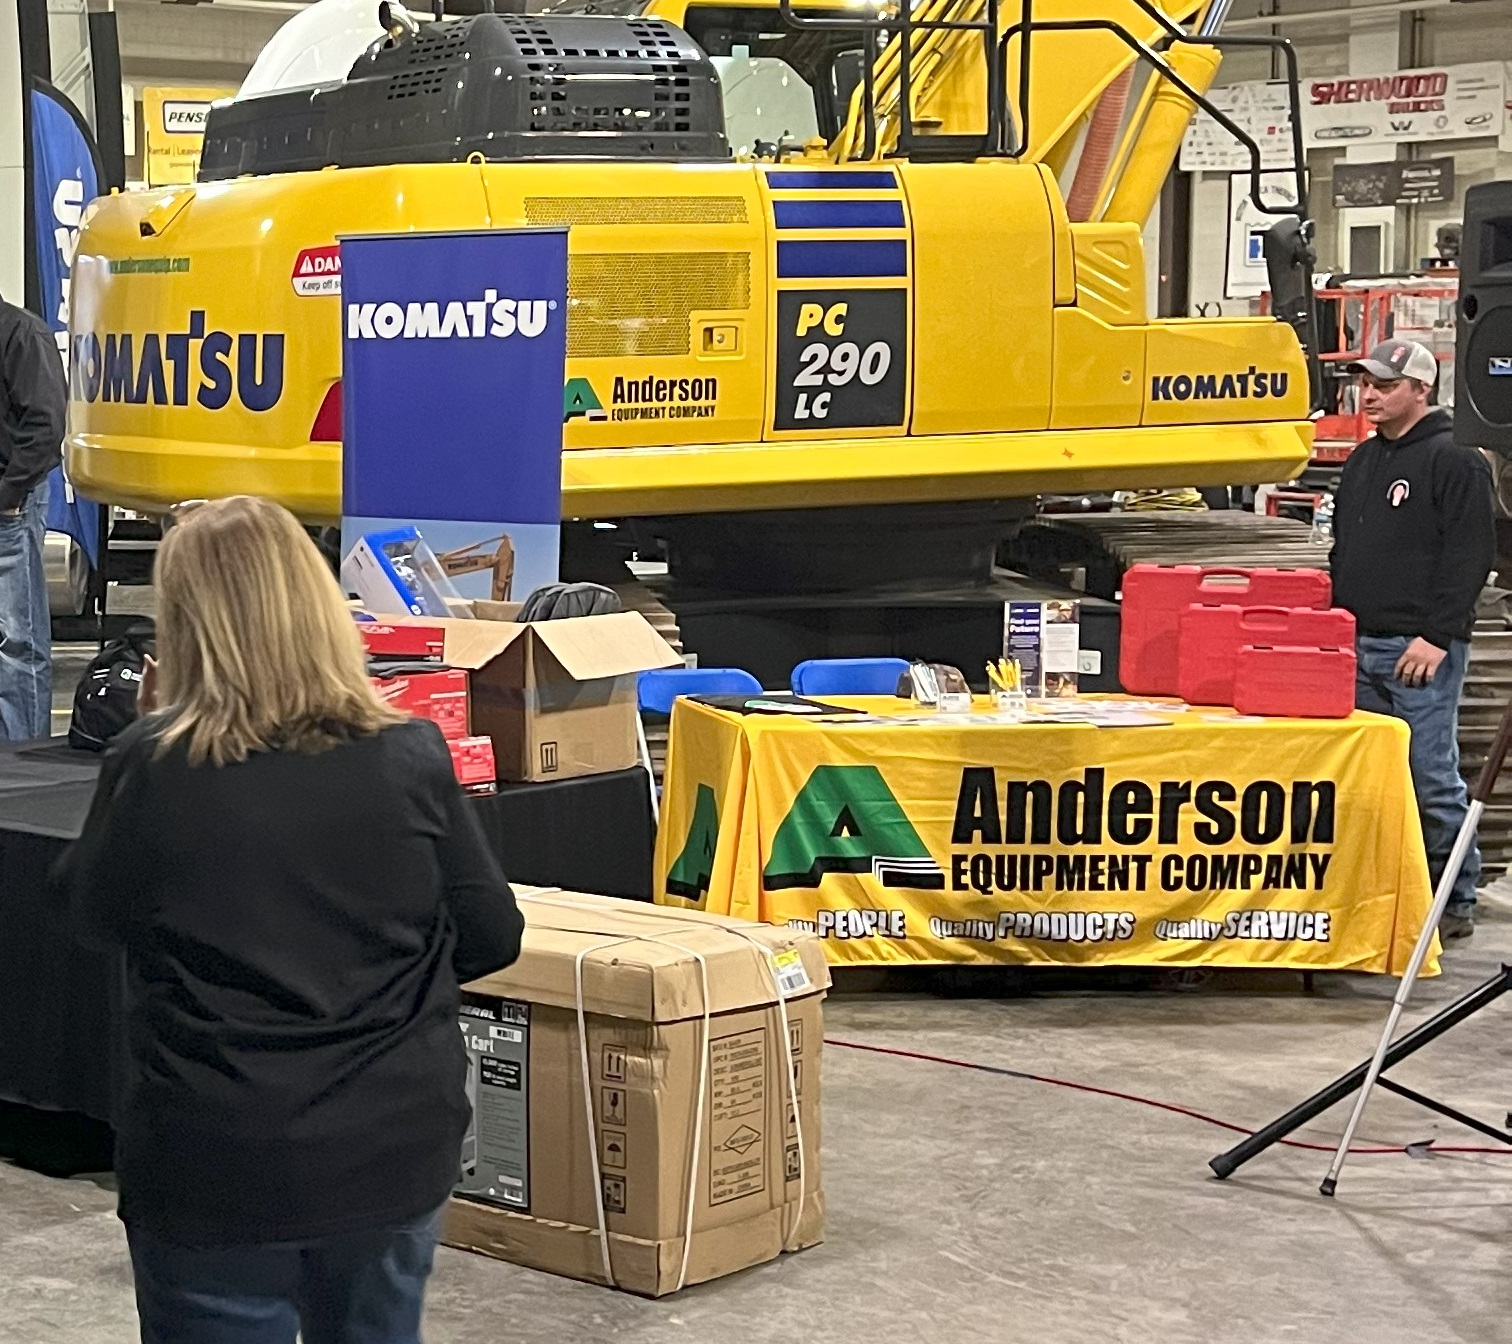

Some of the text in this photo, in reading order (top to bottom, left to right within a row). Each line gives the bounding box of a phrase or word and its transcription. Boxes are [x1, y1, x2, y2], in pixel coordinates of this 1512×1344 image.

[1310, 72, 1448, 105] SHERWOOD
[302, 280, 320, 291] Keep
[322, 279, 332, 289] off
[348, 289, 547, 339] KOMATSU
[796, 302, 848, 336] PC
[793, 341, 891, 386] 290
[612, 376, 717, 405] Anderson
[1151, 366, 1288, 401] KOMATSU
[611, 405, 716, 422] EQUIPMENT COMPANY
[794, 392, 831, 419] LC
[951, 767, 1336, 845] Anderson
[951, 854, 1331, 895] EQUIPMENT COMPANY
[817, 908, 906, 939] PEOPLE
[997, 911, 1136, 942] PRODUCTS
[1223, 910, 1331, 942] SERVICE
